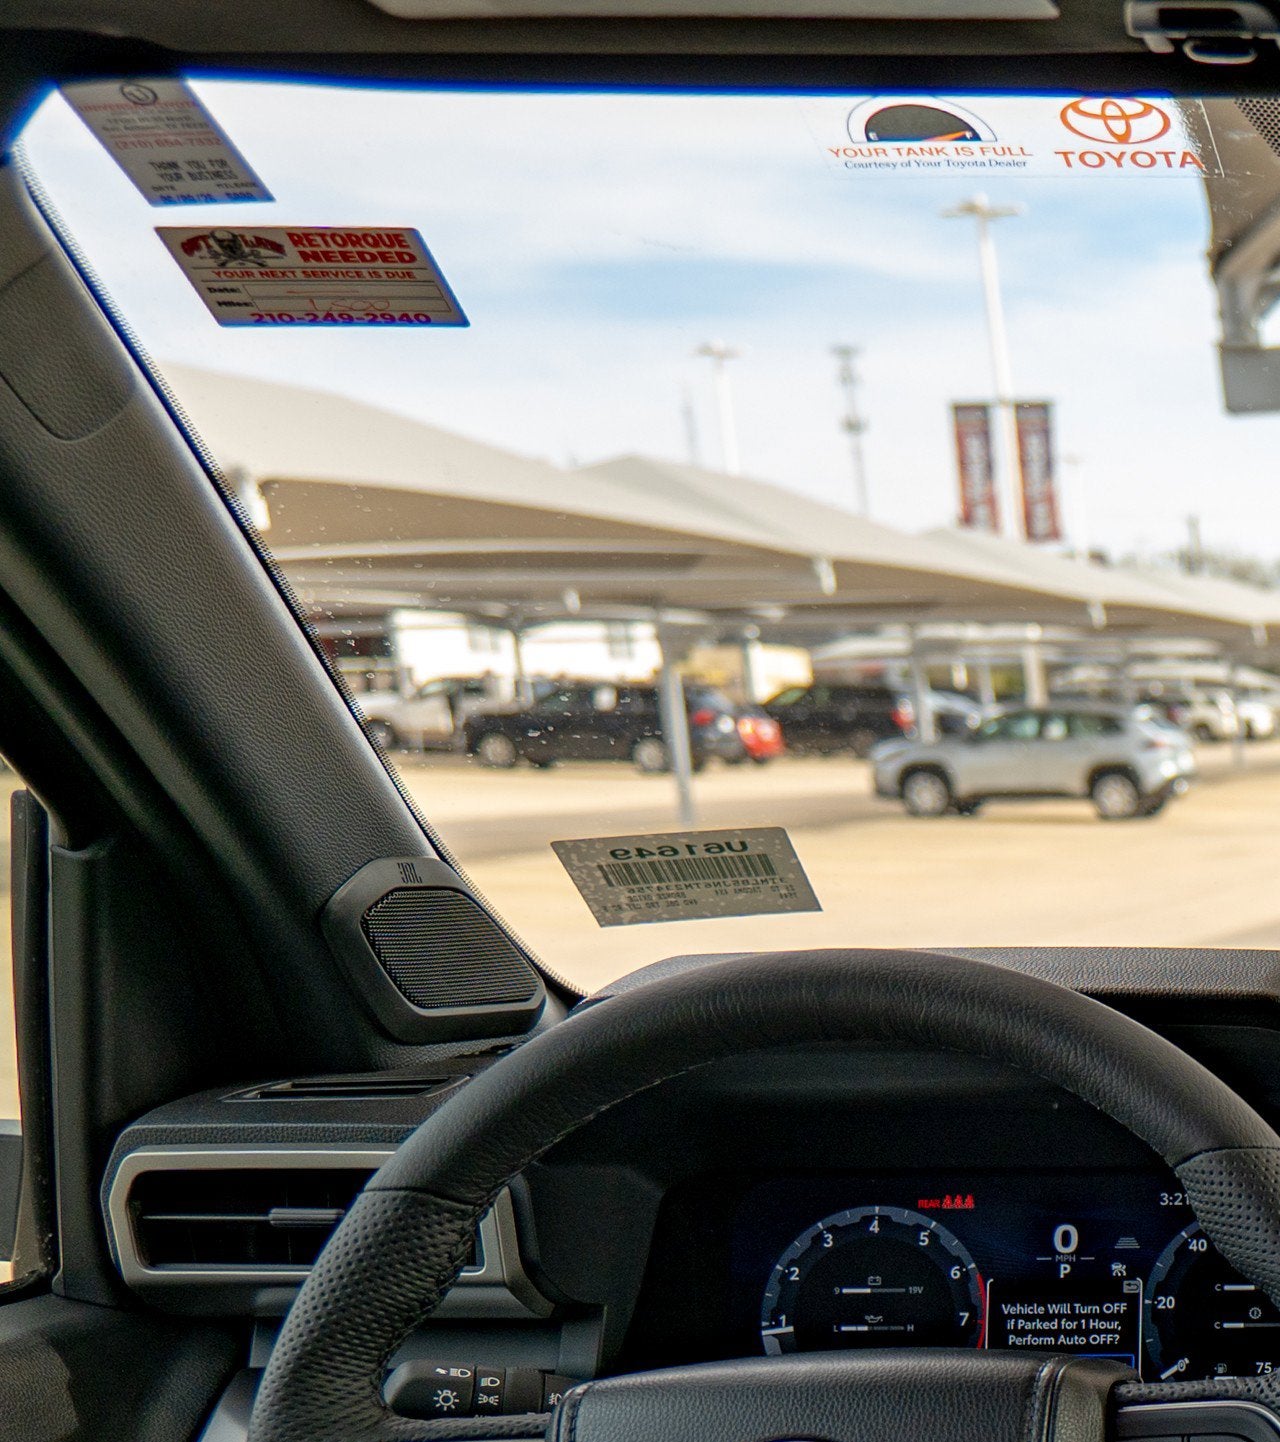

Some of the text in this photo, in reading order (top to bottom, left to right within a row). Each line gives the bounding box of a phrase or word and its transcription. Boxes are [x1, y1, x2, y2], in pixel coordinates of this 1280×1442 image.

[828, 145, 1034, 158] YOUR TANK IS FULL
[185, 160, 206, 171] YOU
[209, 159, 228, 170] FOR
[844, 158, 1028, 171] Courtesy of Your Toyota Dealer
[1055, 151, 1205, 168] TOYOTA
[159, 170, 238, 182] YOUR BUSINESS
[286, 232, 410, 249] RETORQUE
[298, 250, 417, 265] NEEDED
[213, 270, 416, 280] YOUR NEXT SERVICE IS DUE
[250, 313, 432, 324] 210-249-2940
[918, 1199, 940, 1208] REAR
[1160, 1193, 1190, 1206] 3:21
[869, 1219, 880, 1234] 4
[823, 1233, 834, 1248] 3
[919, 1231, 929, 1246] 5
[1053, 1224, 1078, 1253] 0
[1189, 1239, 1207, 1252] 40
[789, 1267, 800, 1281] 2
[950, 1265, 961, 1279] 6
[1060, 1264, 1071, 1278] P
[1002, 1303, 1128, 1315] Vehicle Will Turn OFF
[1158, 1297, 1175, 1309] 20
[959, 1312, 970, 1327] 7
[1007, 1318, 1122, 1331] if Parked for 1 Hour,
[1008, 1334, 1120, 1346] Perform Auto OFF?
